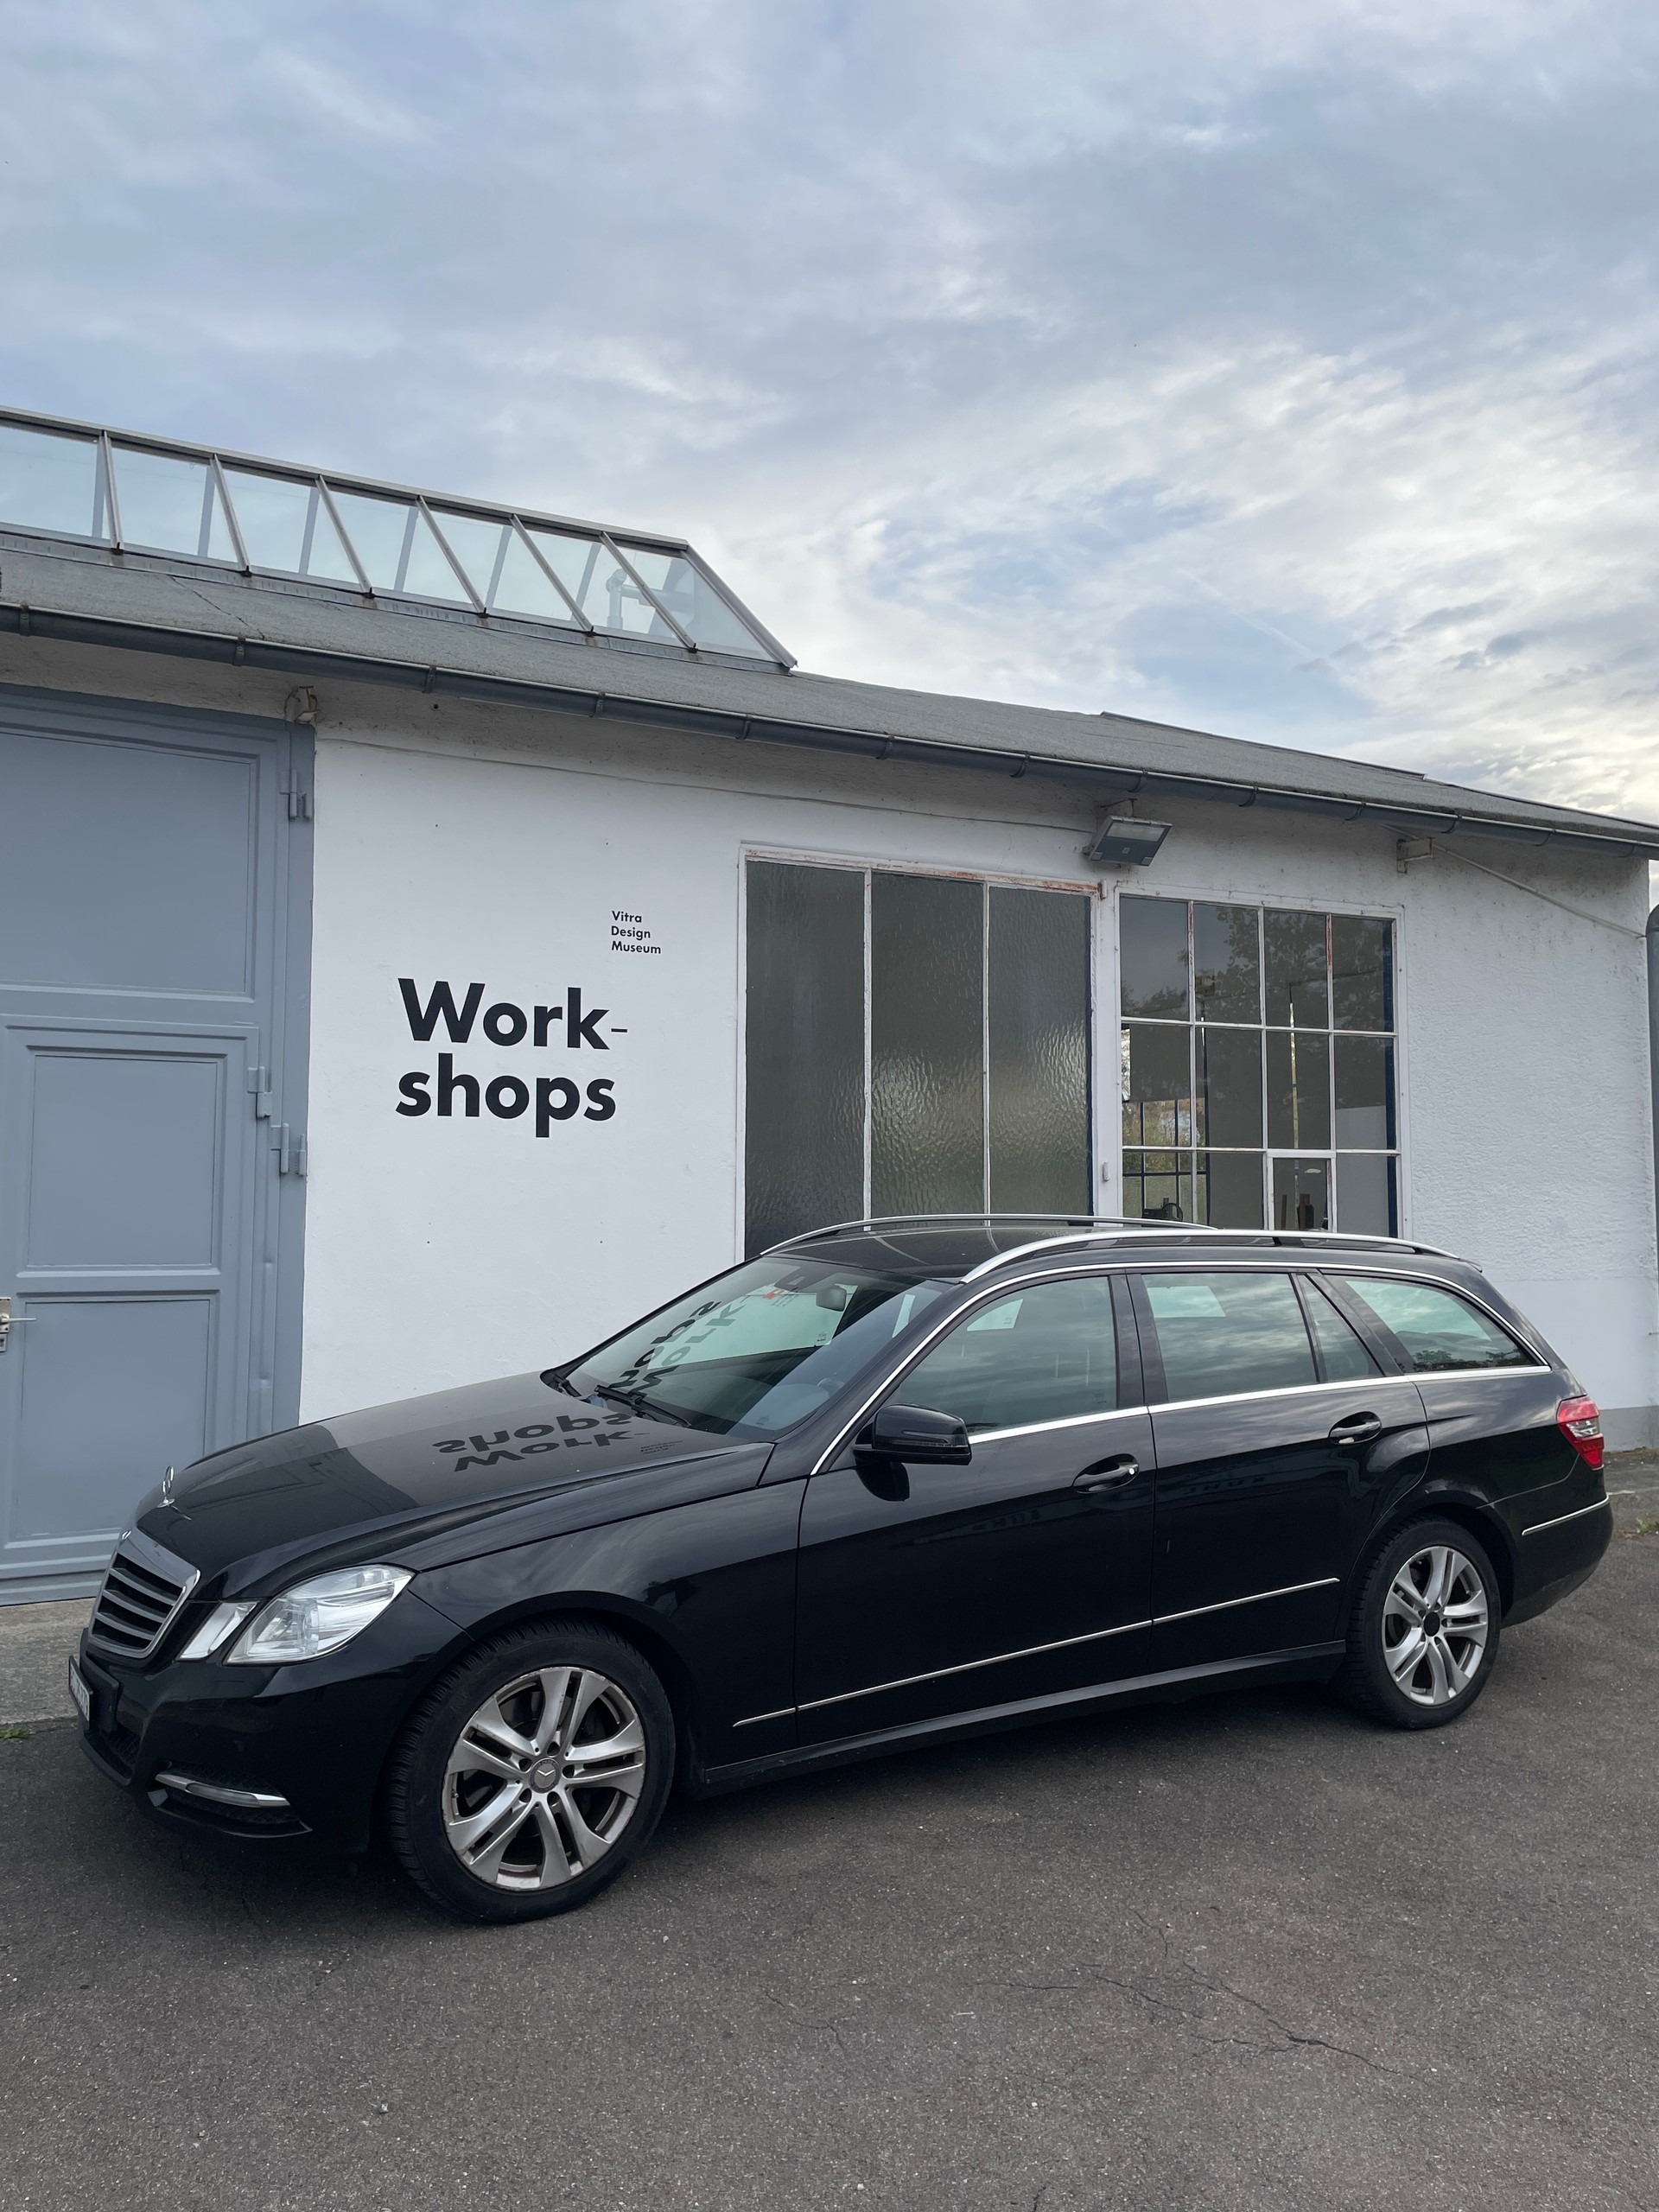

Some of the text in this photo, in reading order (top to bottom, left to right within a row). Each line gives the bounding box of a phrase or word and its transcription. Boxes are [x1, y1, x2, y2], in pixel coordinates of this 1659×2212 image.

[611, 910, 642, 923] Vitra
[611, 925, 651, 941] Design
[611, 940, 661, 954] Museum
[397, 977, 628, 1051] Work-
[395, 1052, 616, 1138] shops
